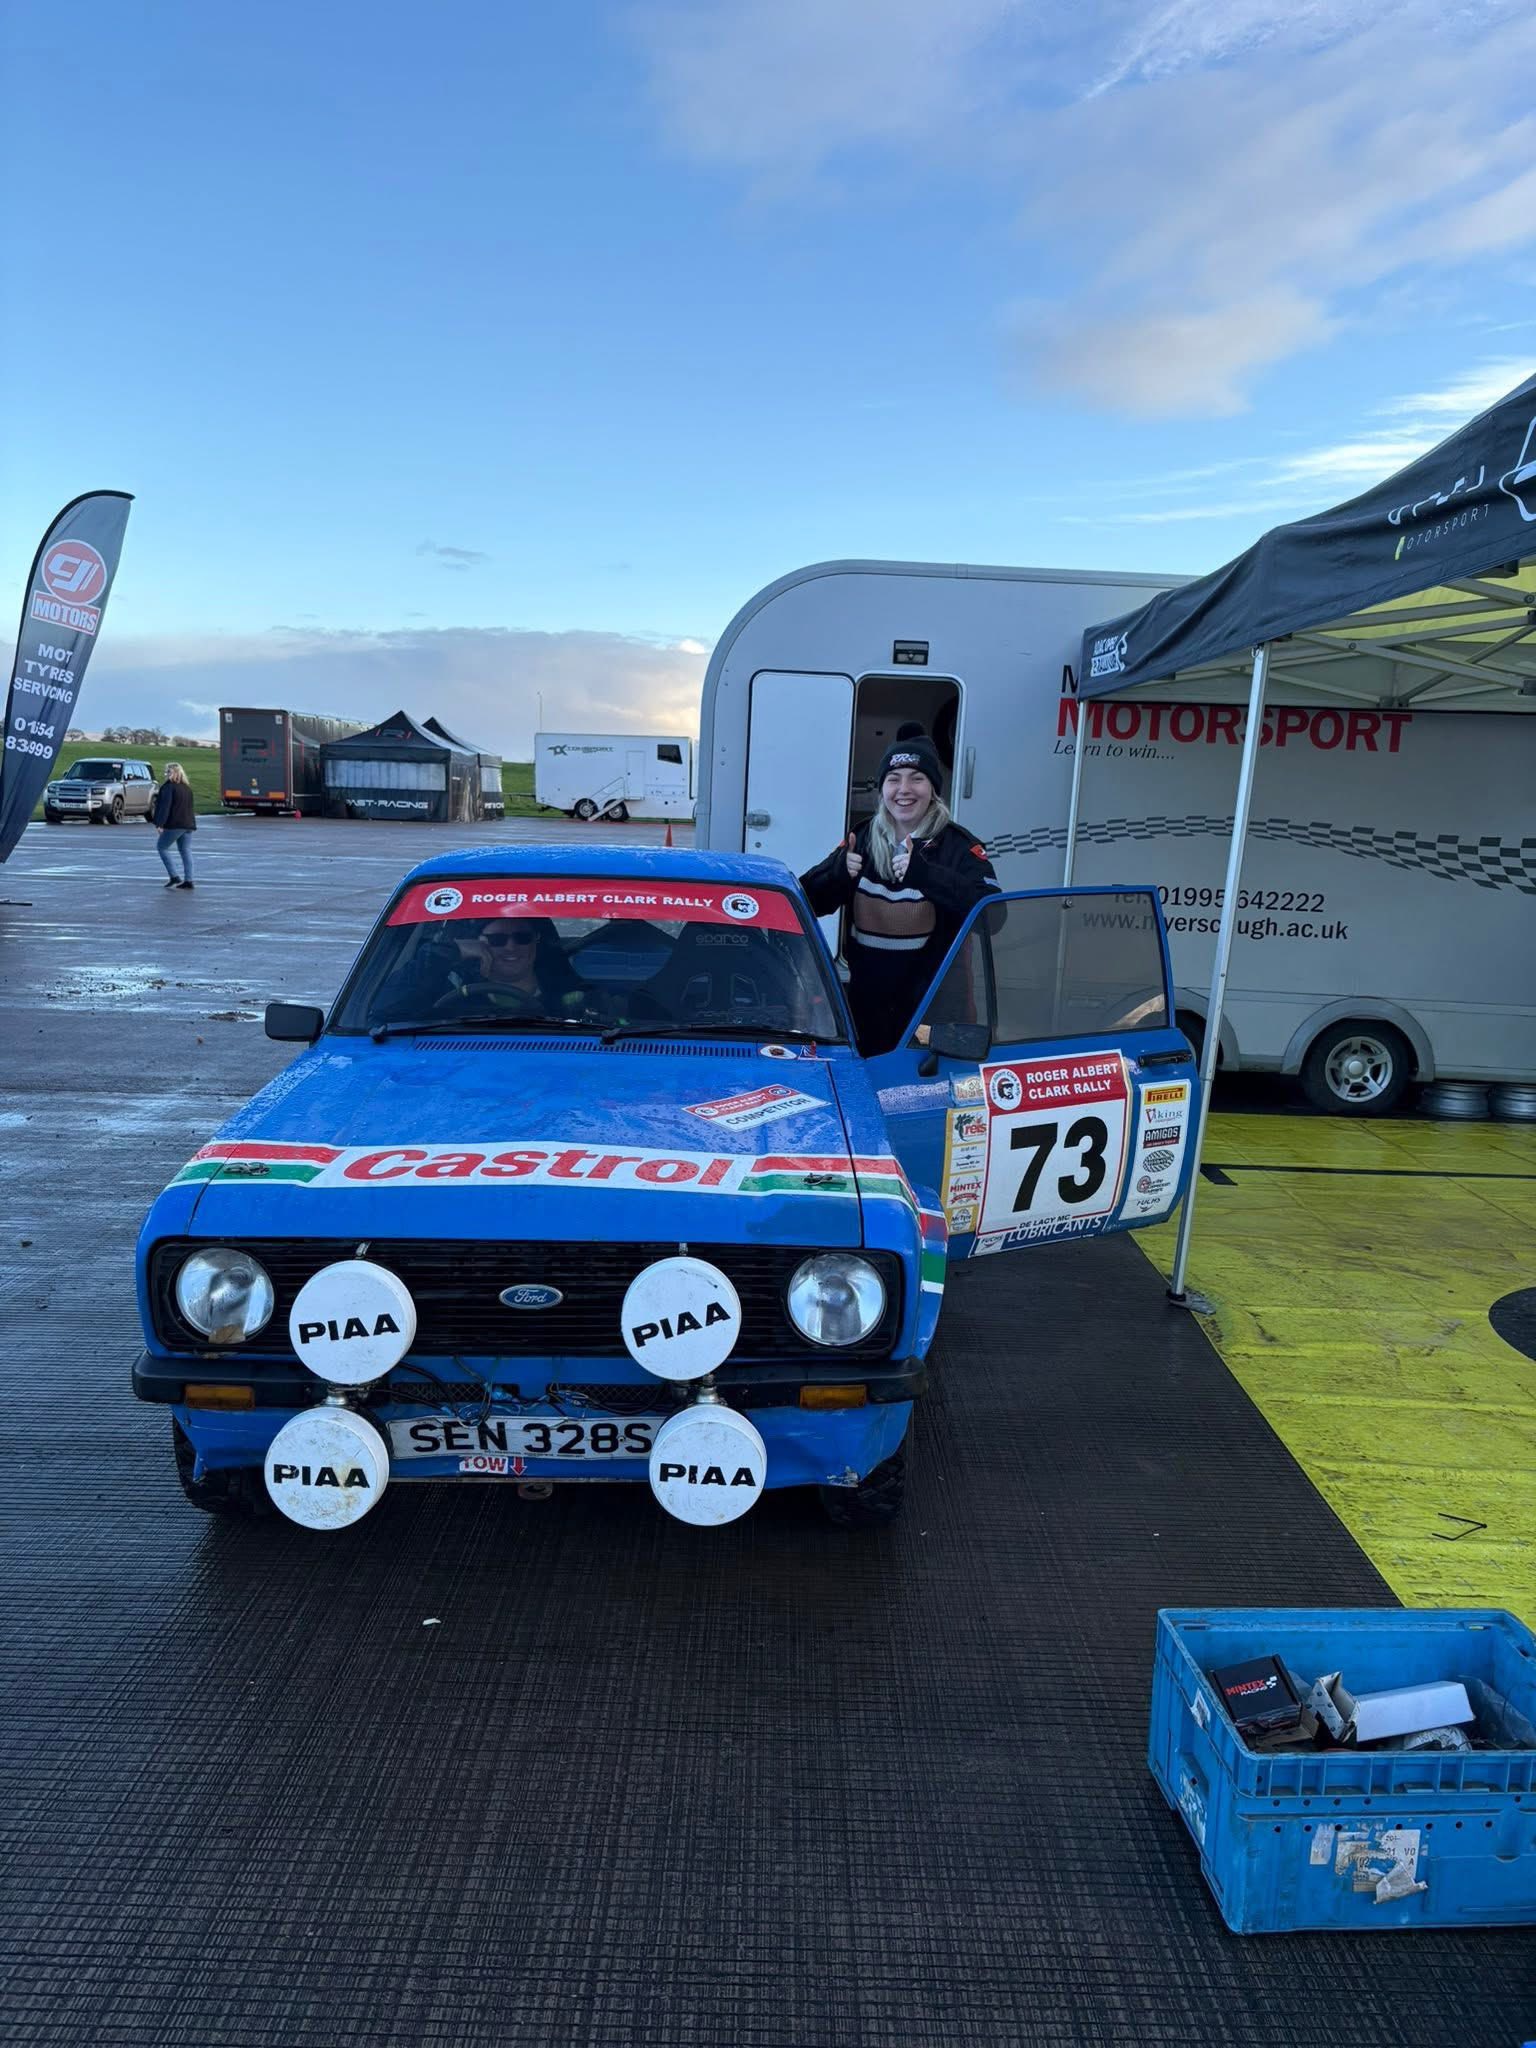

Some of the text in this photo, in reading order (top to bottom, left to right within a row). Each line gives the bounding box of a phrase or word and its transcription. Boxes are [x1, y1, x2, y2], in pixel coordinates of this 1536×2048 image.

[34, 598, 97, 631] MOTORS
[38, 643, 73, 663] MOT
[25, 660, 74, 684] TYRES
[1053, 740, 1100, 756] Lern
[1106, 744, 1123, 758] to
[472, 893, 714, 907] ROGER ALBERT CLARK RALLY
[1158, 886, 1226, 908] 01995
[1238, 890, 1325, 912] 642222
[1026, 1063, 1118, 1084] ROGER ALBERT
[1028, 1084, 1071, 1099] CLARK
[1074, 1079, 1112, 1094] RALLY
[1147, 1087, 1184, 1102] PIRELLI
[725, 1098, 811, 1126] COMPETITOR
[1145, 1108, 1183, 1123] Viking
[1145, 1127, 1179, 1142] AMIGOS
[343, 1149, 734, 1187] Castrol
[1010, 1116, 1109, 1213] 73
[950, 1181, 982, 1193] MINTEX
[1007, 1214, 1103, 1243] LUBRICANTS
[1019, 1221, 1031, 1229] DE
[514, 1288, 548, 1303] Ford
[298, 1313, 401, 1344] PIAA
[632, 1302, 732, 1348] PIAA
[409, 1421, 652, 1455] SEN 328S
[464, 1456, 506, 1473] TOW
[659, 1463, 757, 1487] PIAA
[273, 1463, 371, 1489] PIAA
[1225, 1680, 1265, 1696] MINTEX
